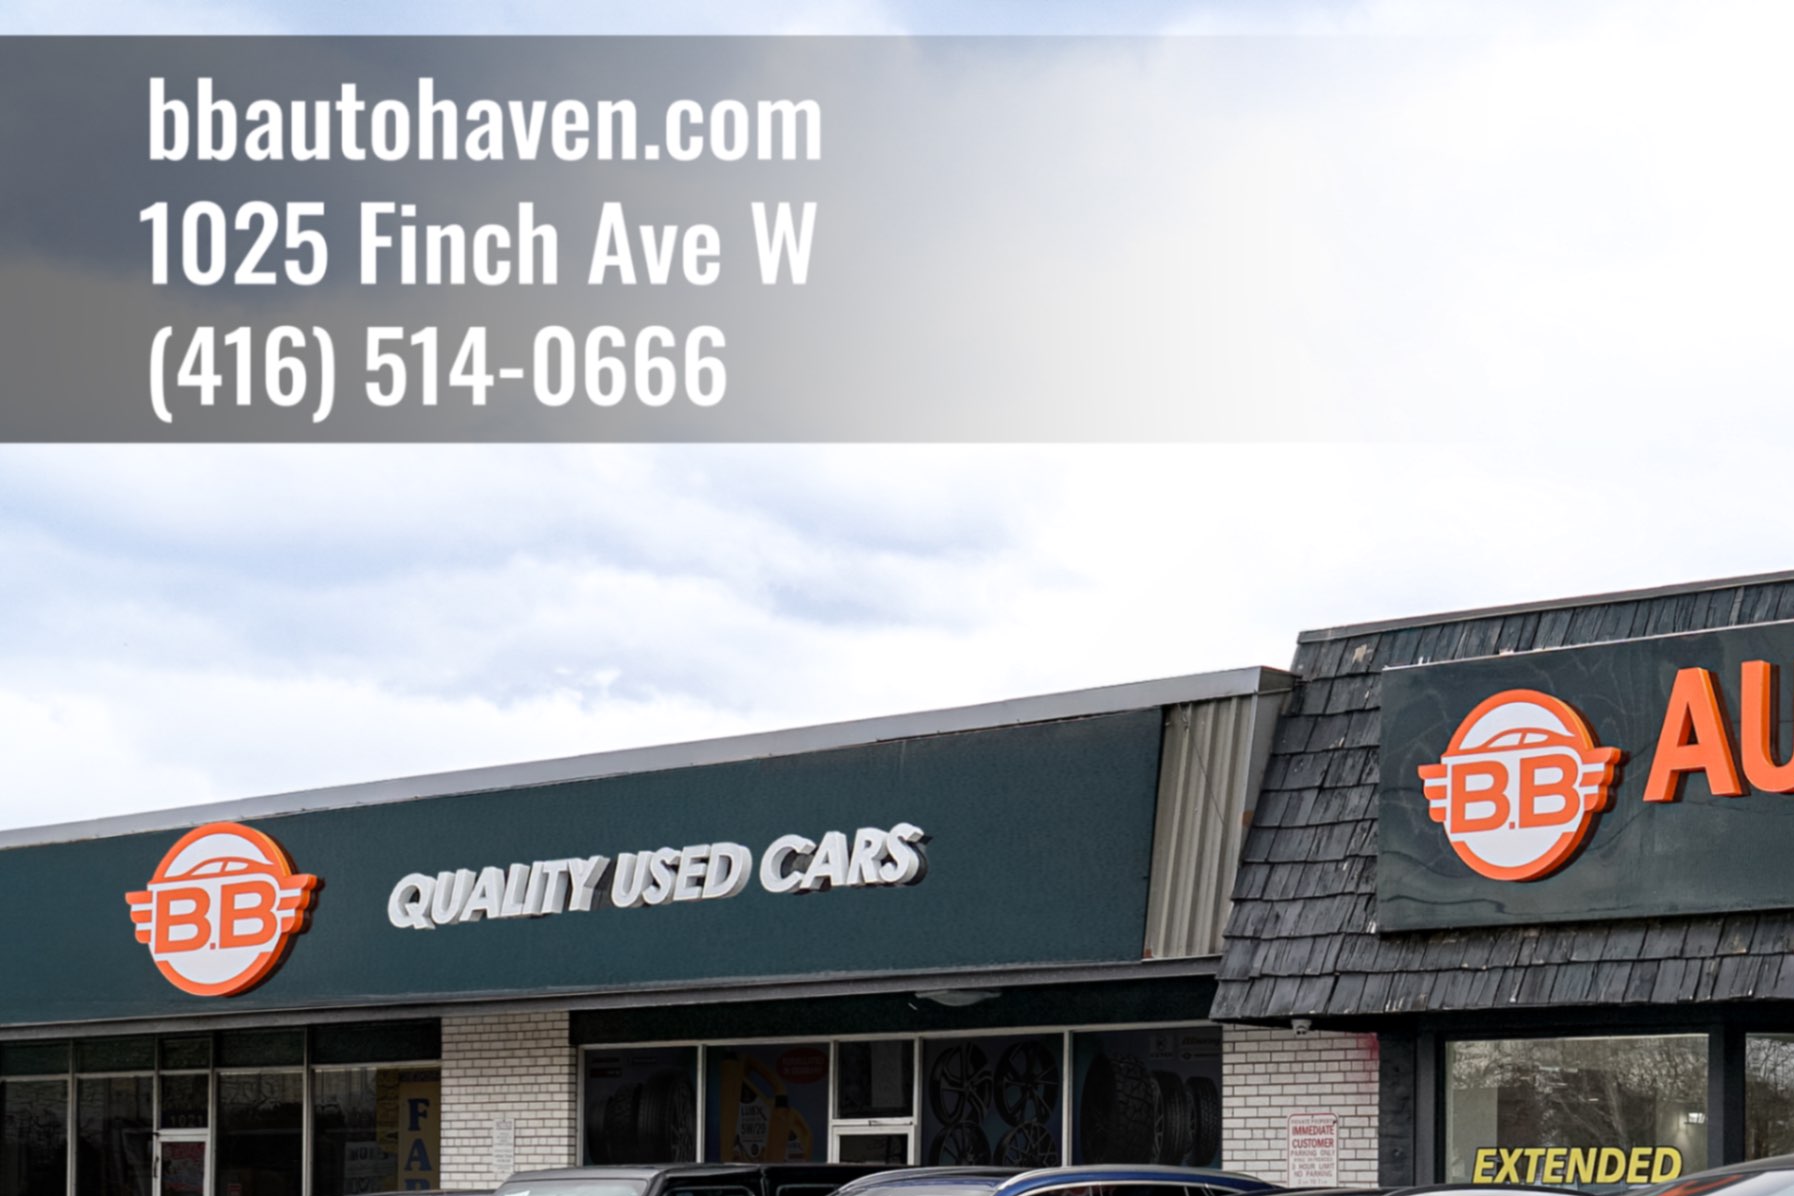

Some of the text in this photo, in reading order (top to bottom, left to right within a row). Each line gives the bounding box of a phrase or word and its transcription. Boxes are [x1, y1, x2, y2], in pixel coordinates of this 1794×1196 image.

[388, 823, 930, 930] QUALITY USED CARS
[1292, 1125, 1335, 1136] IMMEDIATE
[1292, 1138, 1334, 1149] CUSTOMER
[1473, 1146, 1682, 1184] EXTENDED
